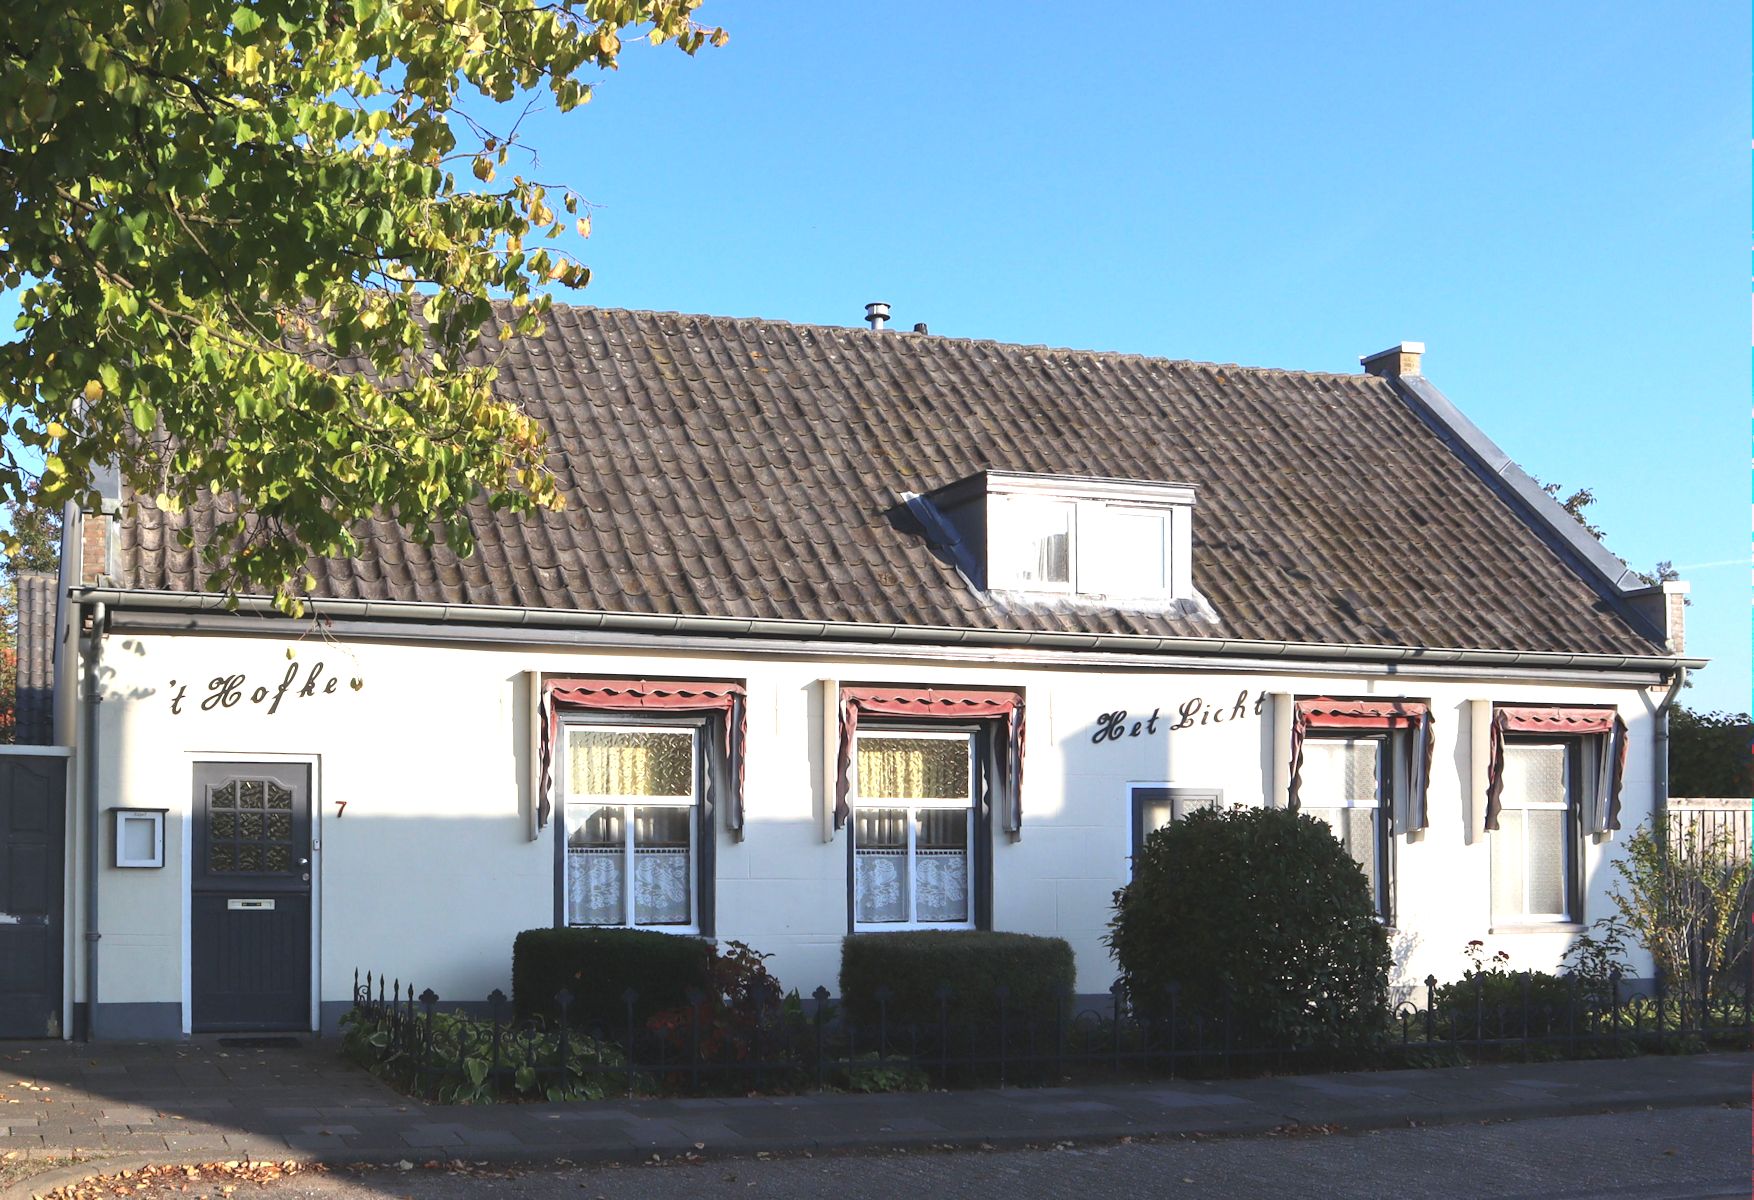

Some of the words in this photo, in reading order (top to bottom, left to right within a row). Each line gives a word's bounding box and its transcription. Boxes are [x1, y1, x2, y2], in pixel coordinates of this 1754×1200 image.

[169, 679, 187, 715] 't
[201, 661, 338, 715] Hofke
[1092, 707, 1160, 744] Het
[1170, 689, 1266, 731] Licht
[335, 801, 347, 818] 7
